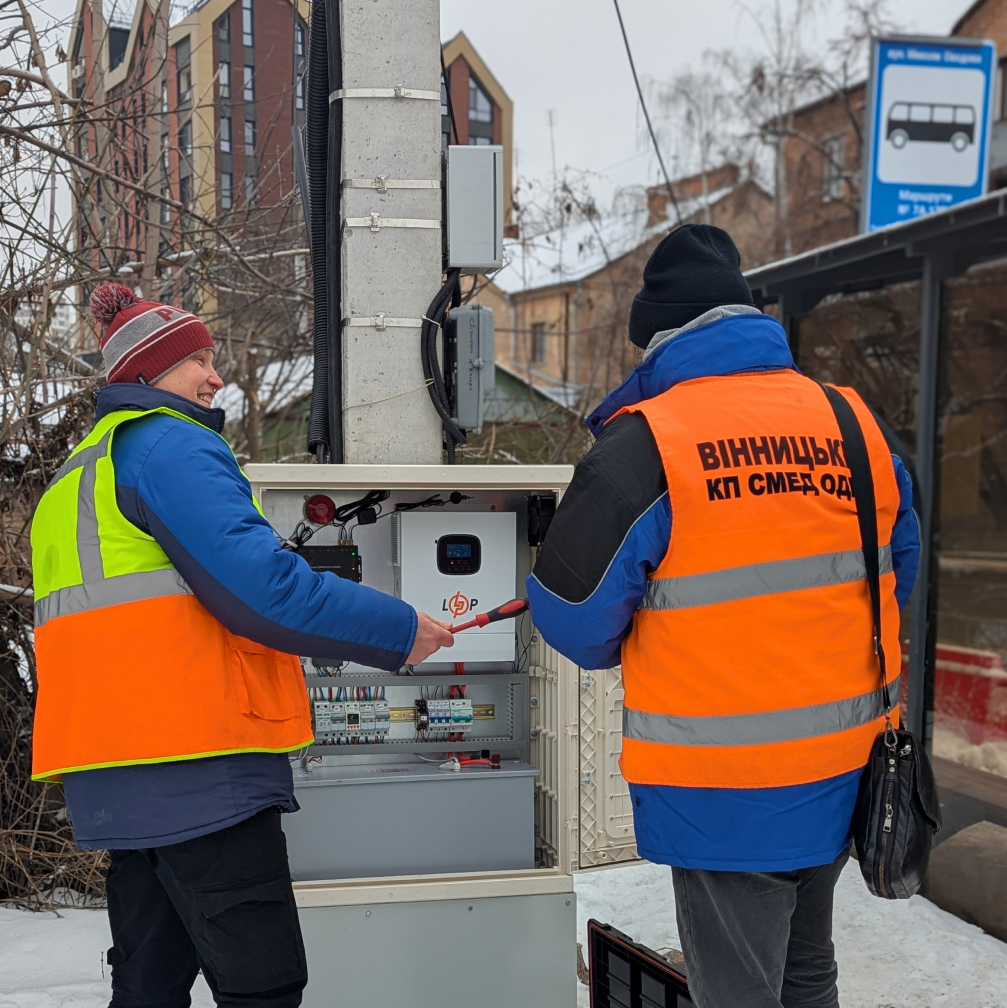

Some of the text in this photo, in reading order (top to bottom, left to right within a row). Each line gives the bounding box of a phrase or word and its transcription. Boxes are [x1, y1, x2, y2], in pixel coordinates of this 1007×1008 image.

[696, 435, 849, 471] ВІННИЦЬК
[706, 472, 856, 502] КП СМЕД ОД
